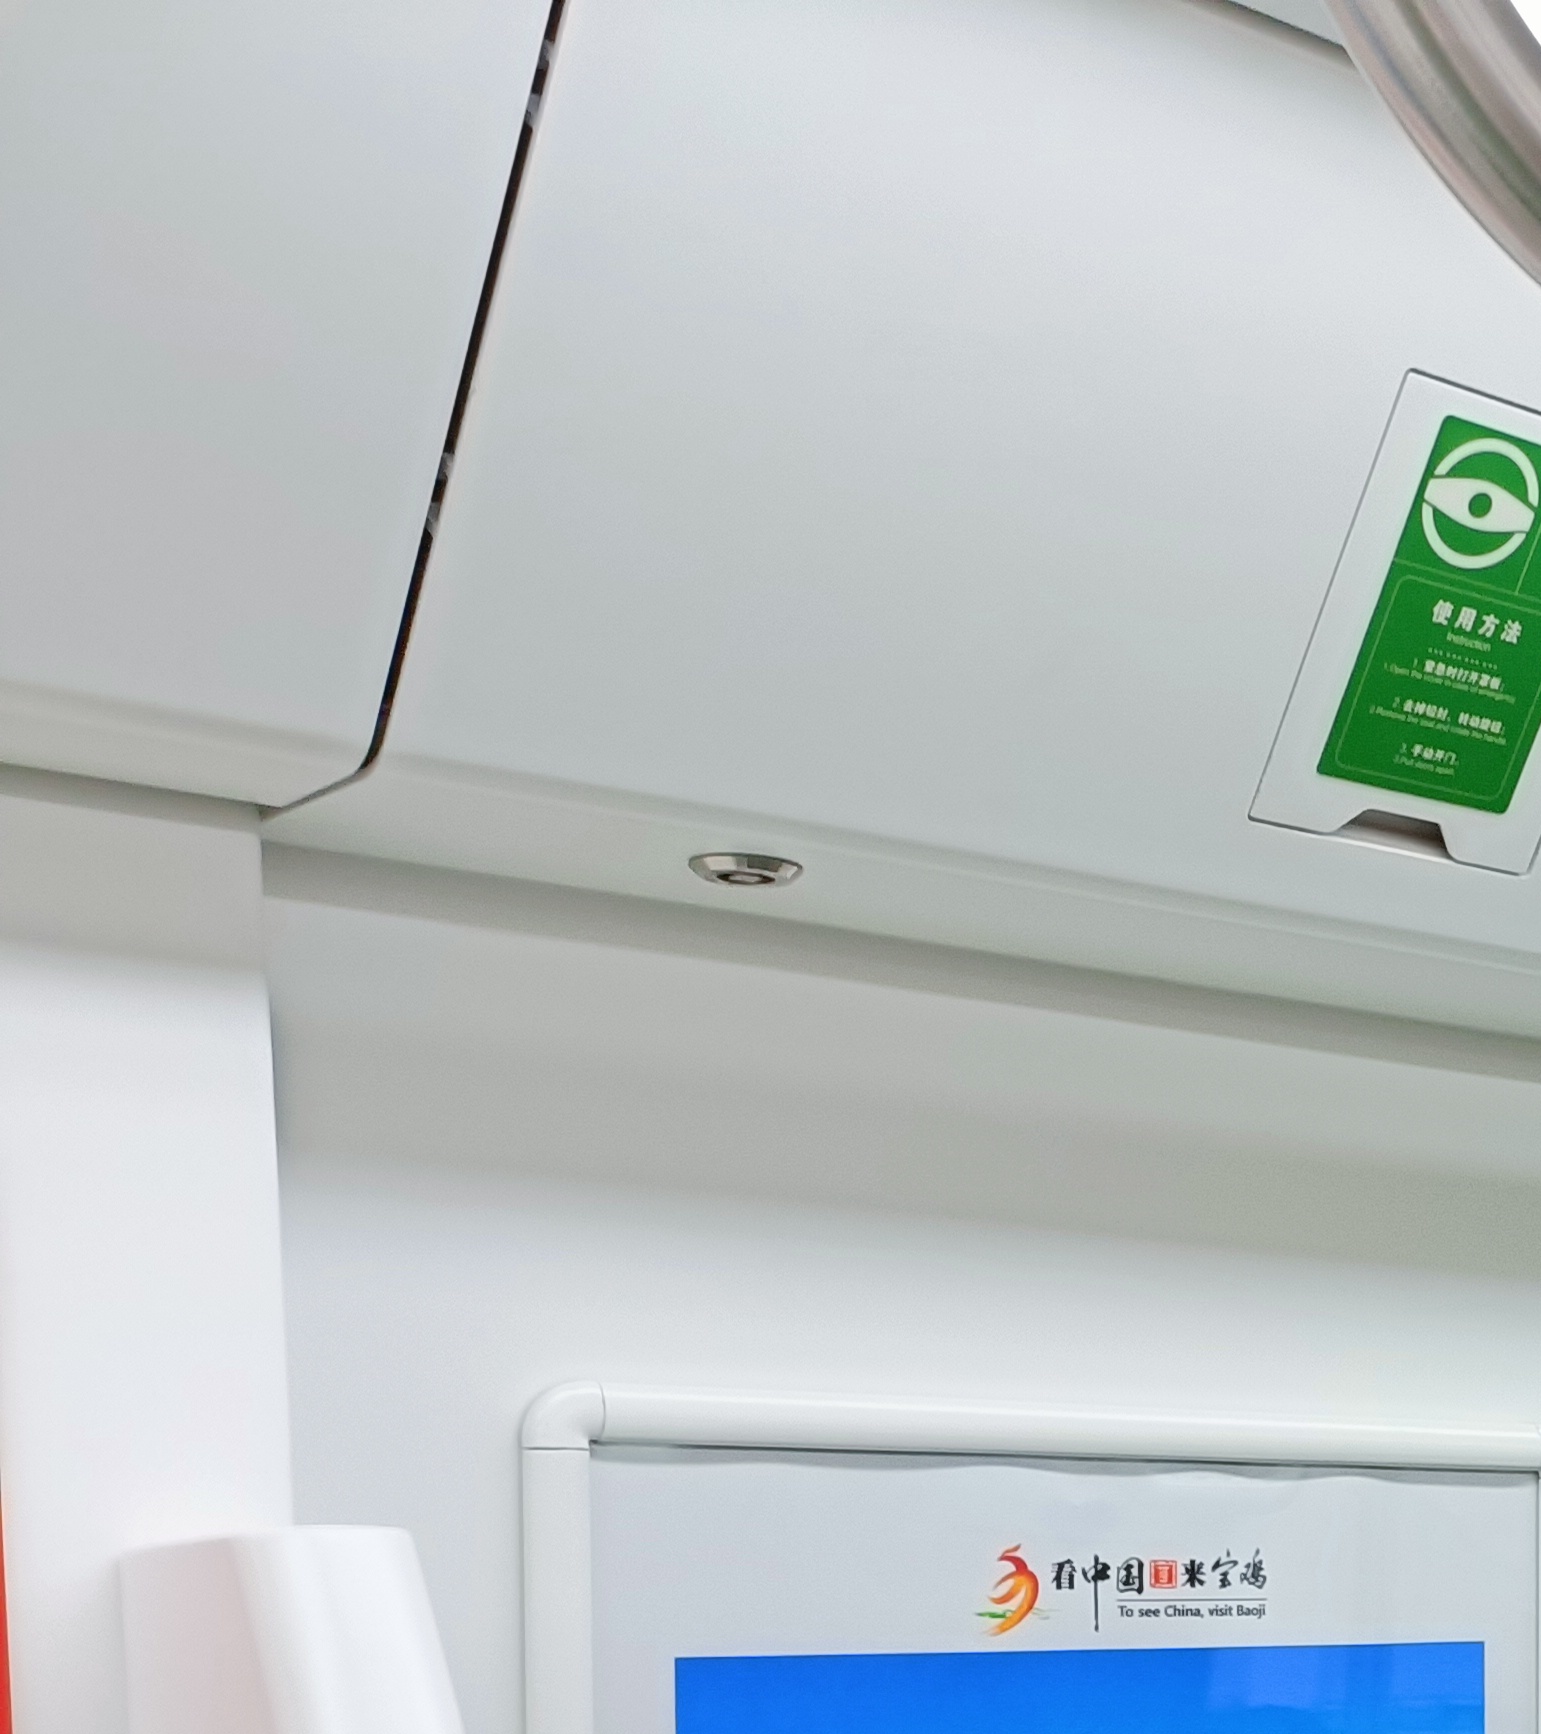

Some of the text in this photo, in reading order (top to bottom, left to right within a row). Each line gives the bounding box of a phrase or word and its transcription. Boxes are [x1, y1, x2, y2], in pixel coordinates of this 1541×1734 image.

[1432, 599, 1522, 645] 使用方法
[1118, 1603, 1266, 1618] To see China, visit Baoji
